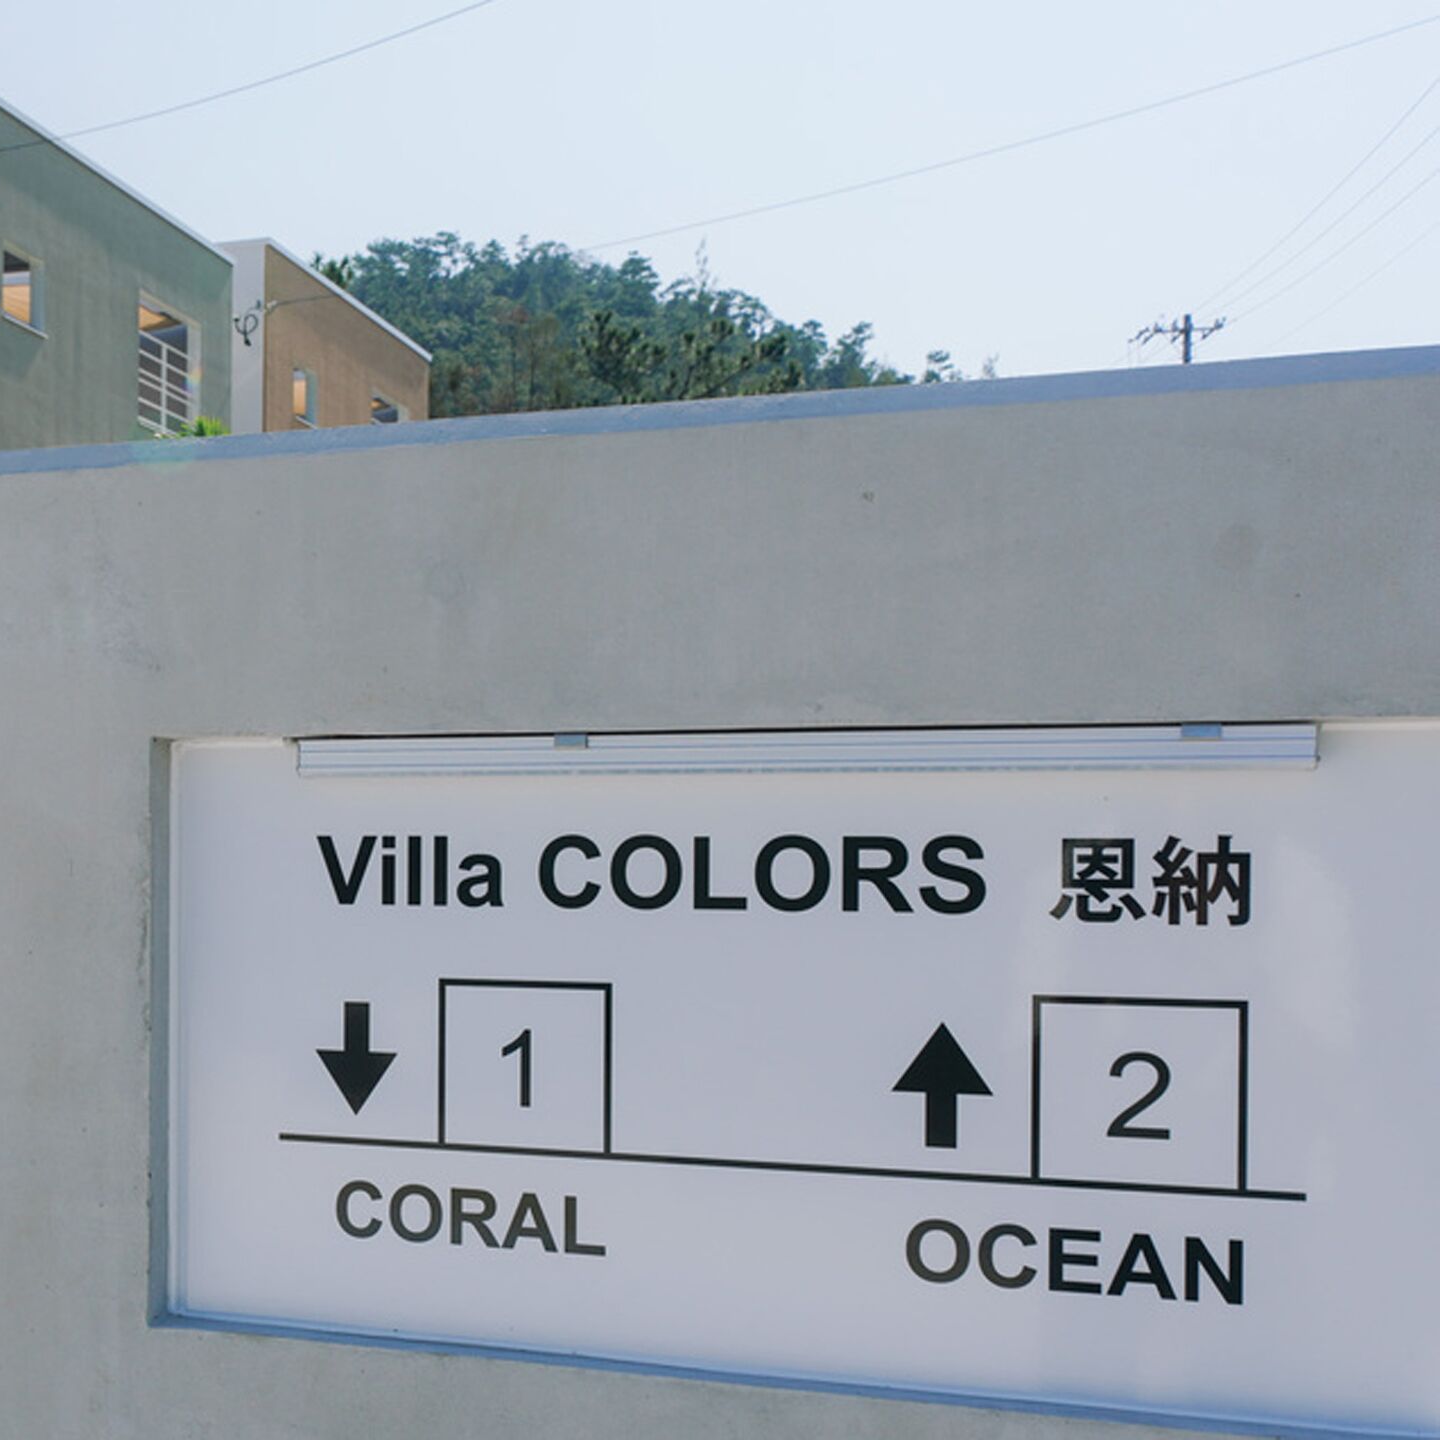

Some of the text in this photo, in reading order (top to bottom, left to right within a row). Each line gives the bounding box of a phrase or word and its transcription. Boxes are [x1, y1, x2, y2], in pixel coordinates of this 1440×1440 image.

[317, 835, 1252, 926] Villa COLORS 恩納
[501, 1029, 532, 1107] 1
[1106, 1052, 1171, 1140] 2
[335, 1180, 607, 1257] CORAL
[905, 1219, 1244, 1305] OCEAN
